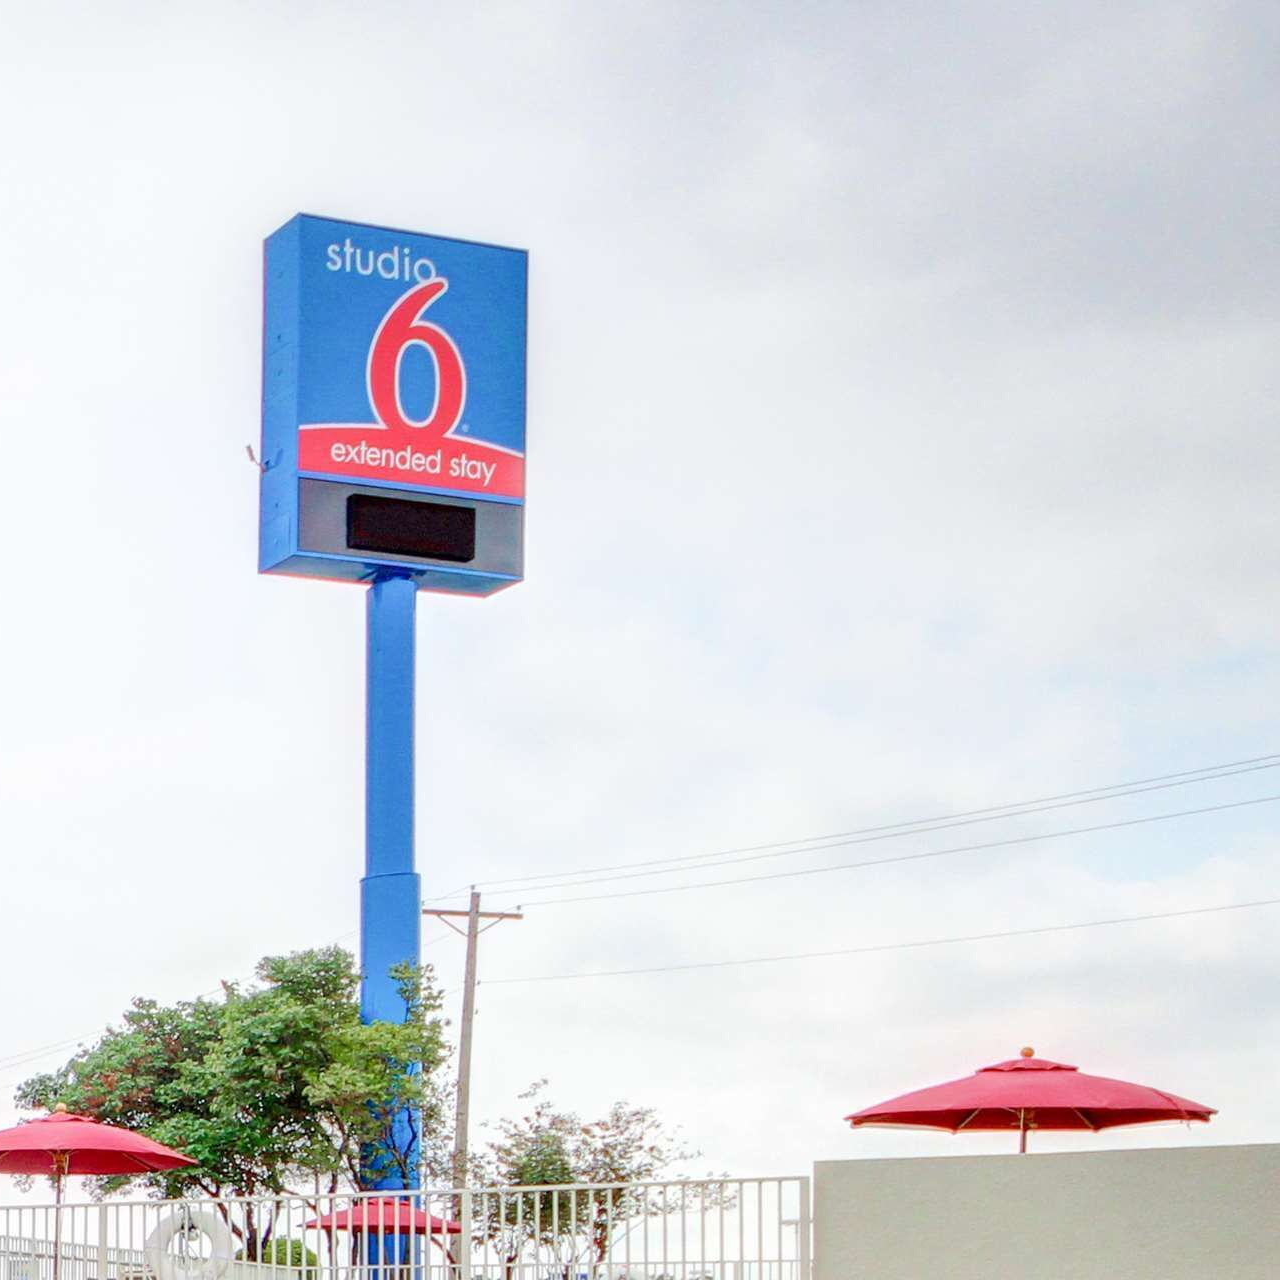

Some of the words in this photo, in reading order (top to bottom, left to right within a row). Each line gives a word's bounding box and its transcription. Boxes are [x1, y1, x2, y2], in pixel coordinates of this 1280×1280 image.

[325, 238, 437, 284] studio
[366, 276, 468, 438] 6
[330, 440, 442, 474] extended
[448, 453, 497, 487] stay
